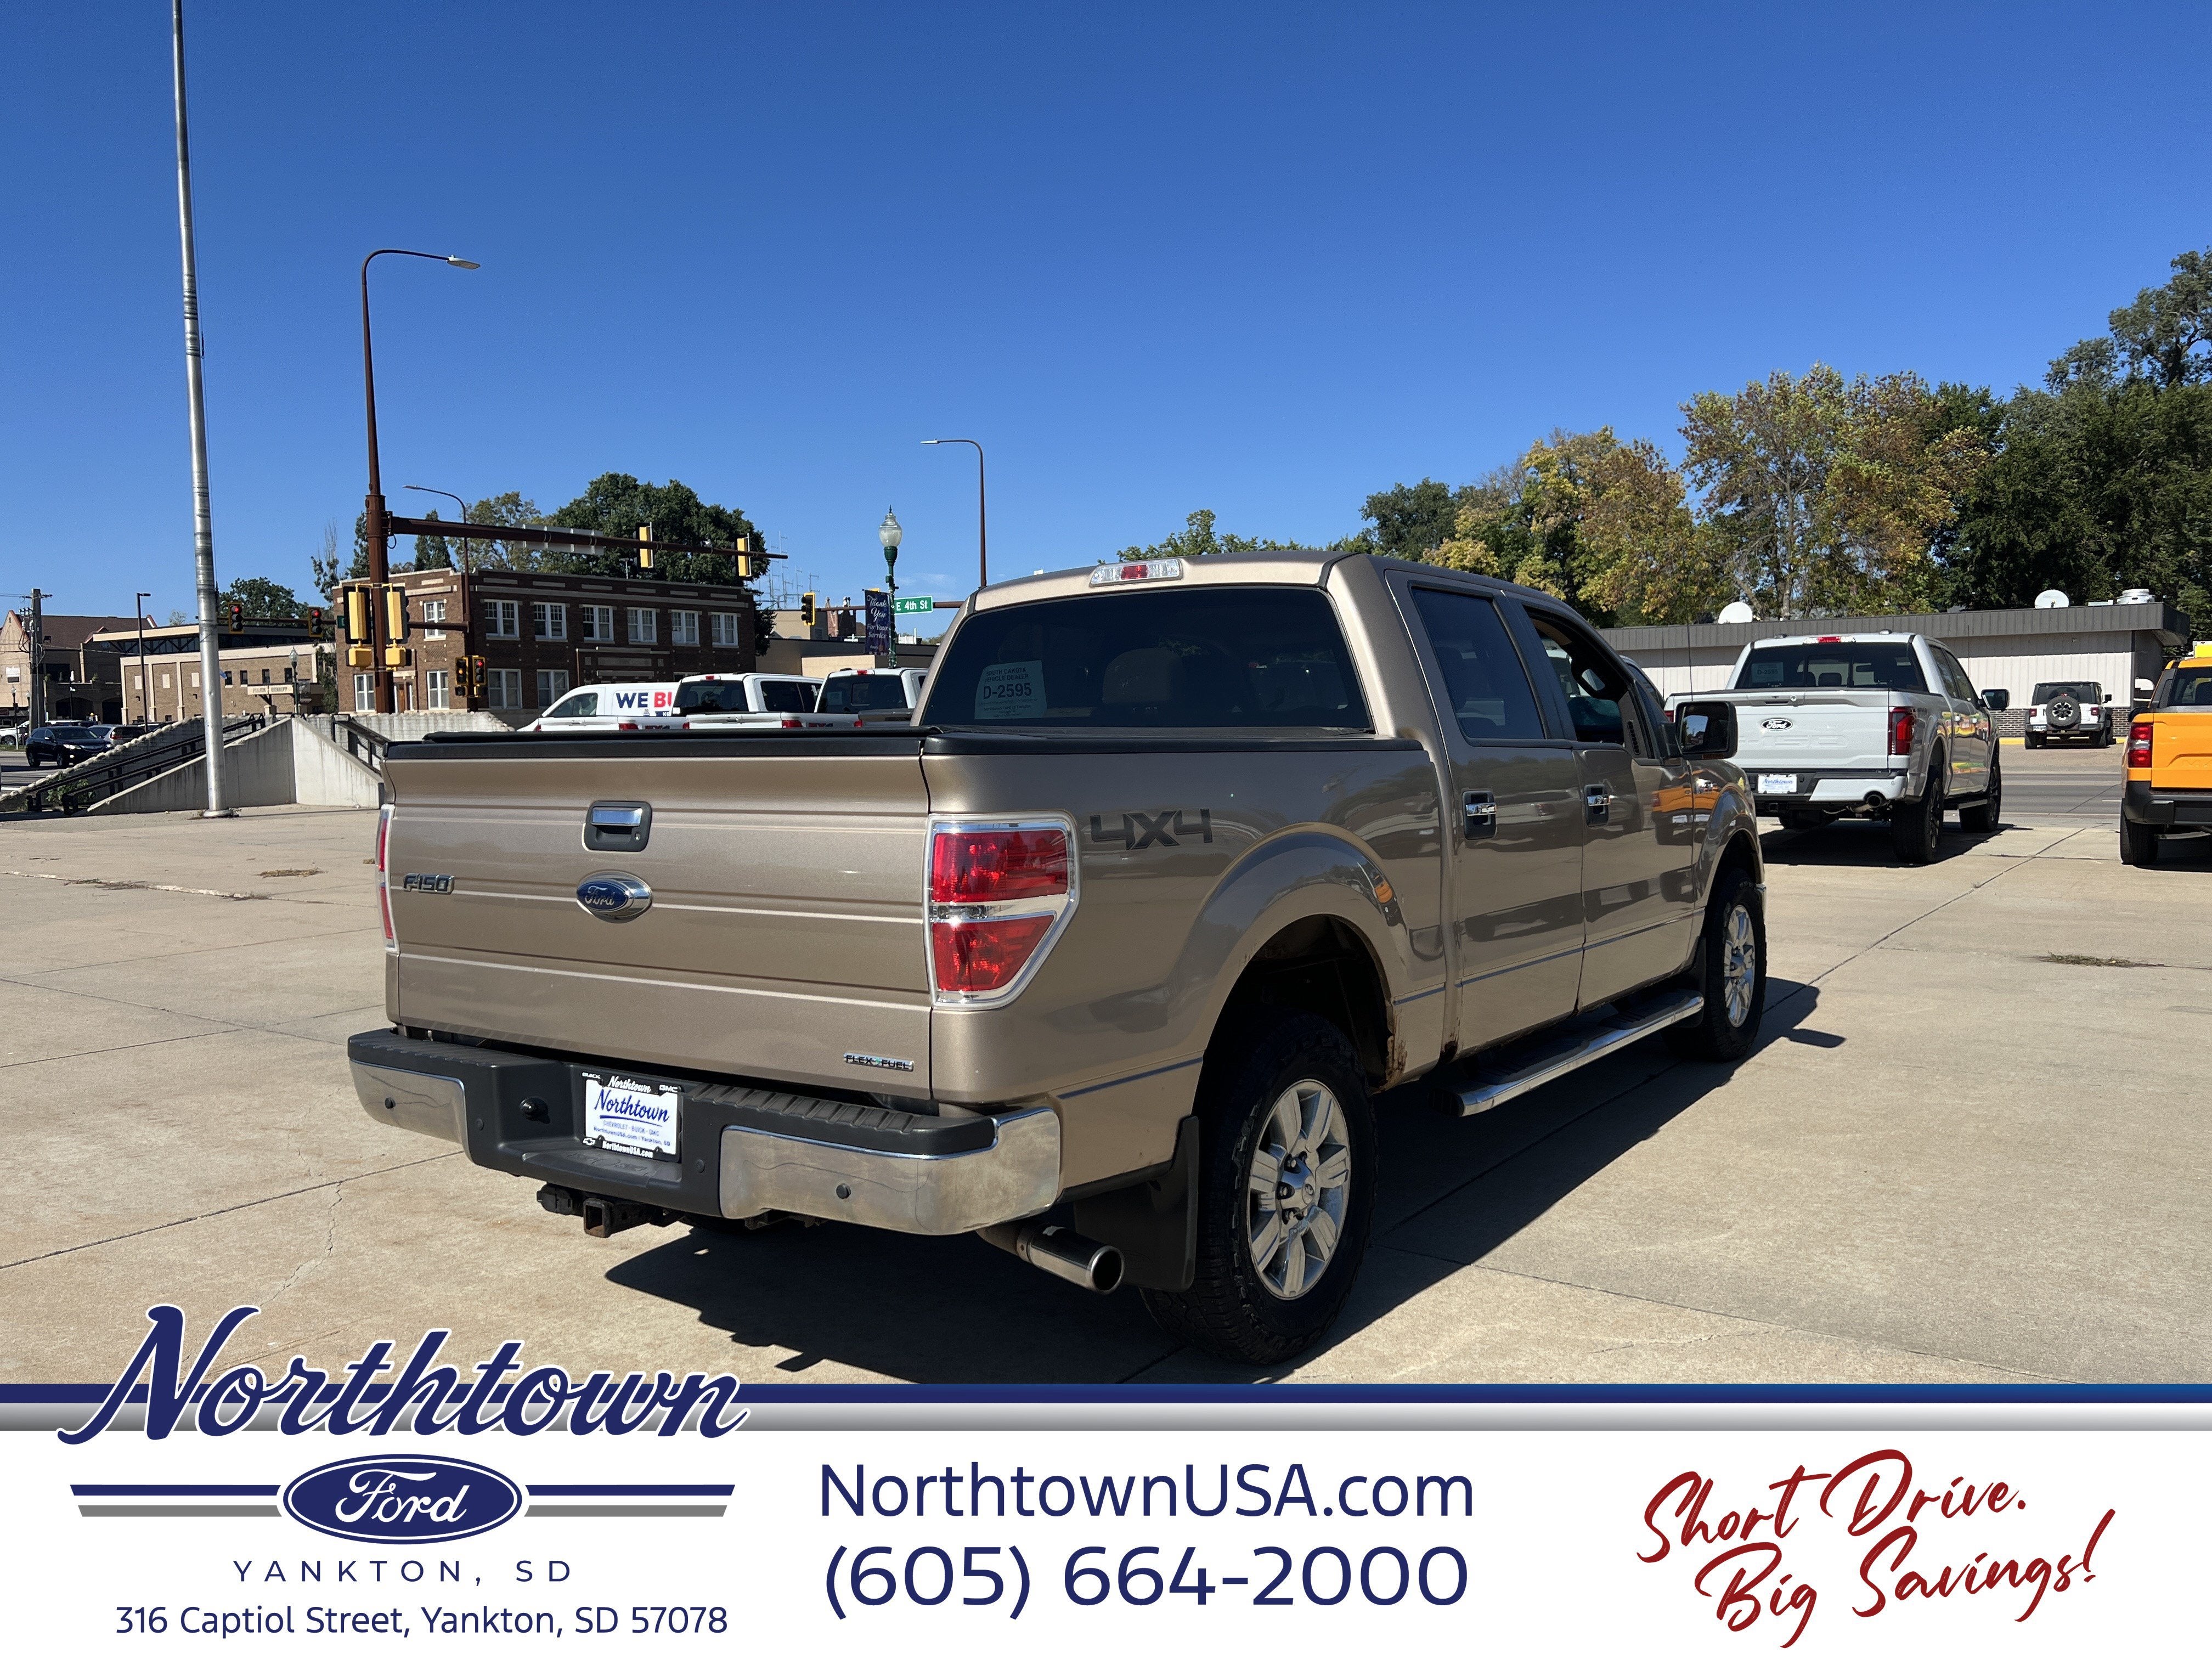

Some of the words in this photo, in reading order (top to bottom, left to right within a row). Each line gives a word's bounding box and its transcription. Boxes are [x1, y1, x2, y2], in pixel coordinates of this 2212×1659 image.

[896, 601, 901, 611] E
[904, 601, 917, 611] 4th
[919, 600, 928, 610] St
[871, 607, 887, 622] You
[983, 682, 1032, 699] D-2595
[616, 692, 649, 708] WE
[1766, 720, 1787, 730] Ford
[1089, 808, 1213, 850] 4X4
[584, 885, 616, 906] Ford
[845, 1054, 873, 1065] FLEX
[881, 1059, 910, 1070] FUEL
[607, 1075, 652, 1093] Northtown
[659, 1084, 678, 1093] GMC
[594, 1088, 670, 1122] Northtown
[603, 1120, 628, 1130] CHEVROLET
[631, 1125, 646, 1133] BUICK
[602, 1140, 653, 1159] NorthtownUSA.com
